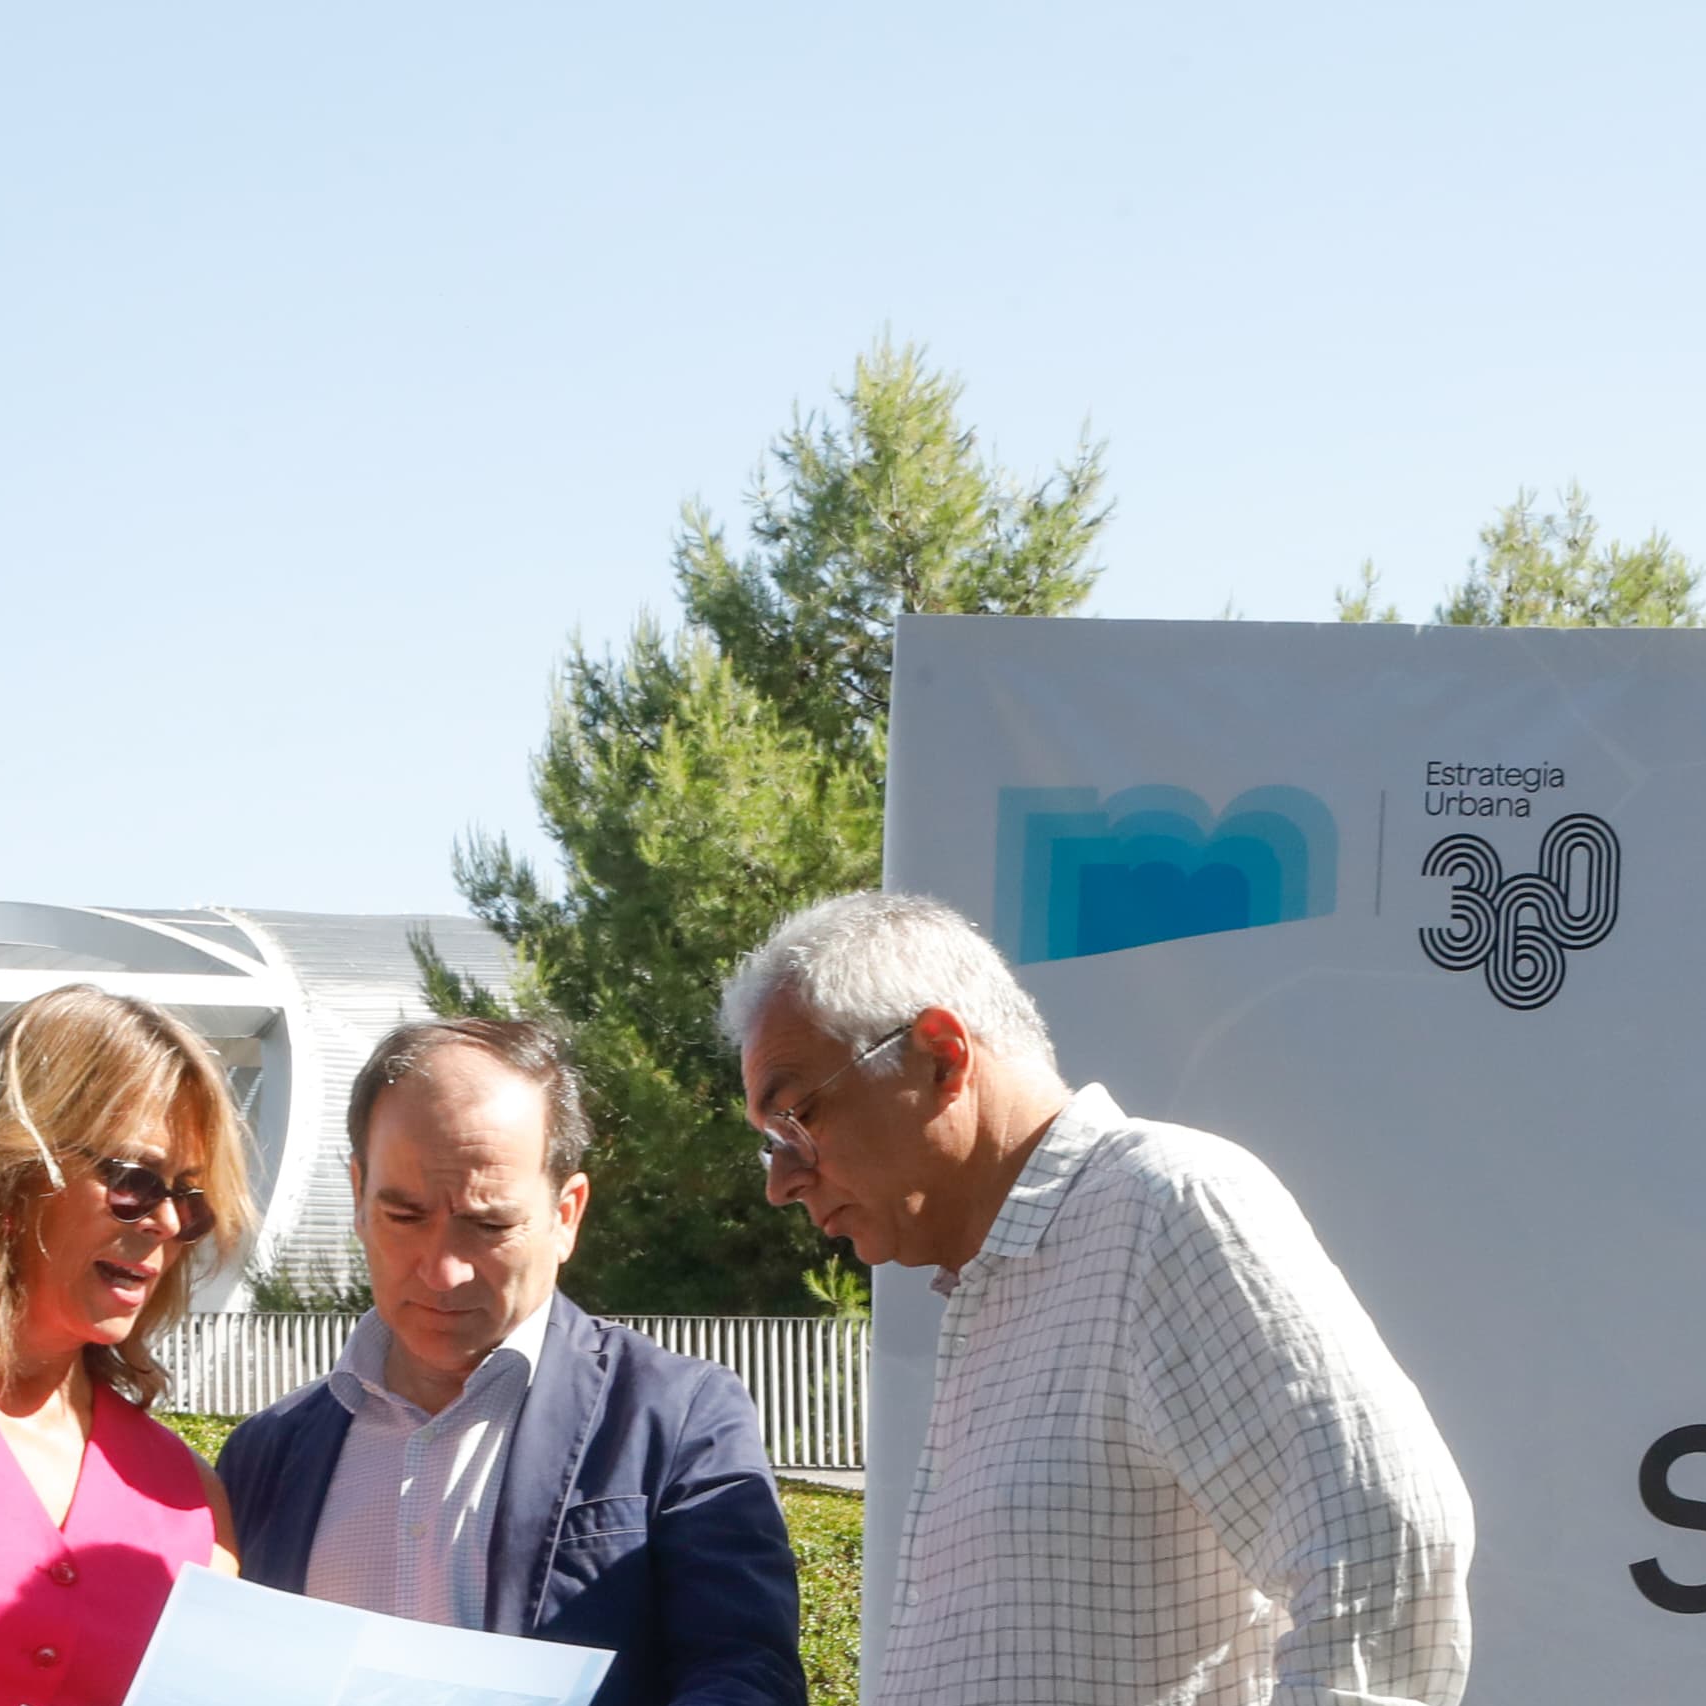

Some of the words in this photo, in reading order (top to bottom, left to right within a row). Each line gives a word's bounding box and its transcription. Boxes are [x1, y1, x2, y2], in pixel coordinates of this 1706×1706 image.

[1426, 760, 1565, 793] Estrategia
[1424, 790, 1531, 818] Urbana
[1419, 812, 1621, 1010] 360
